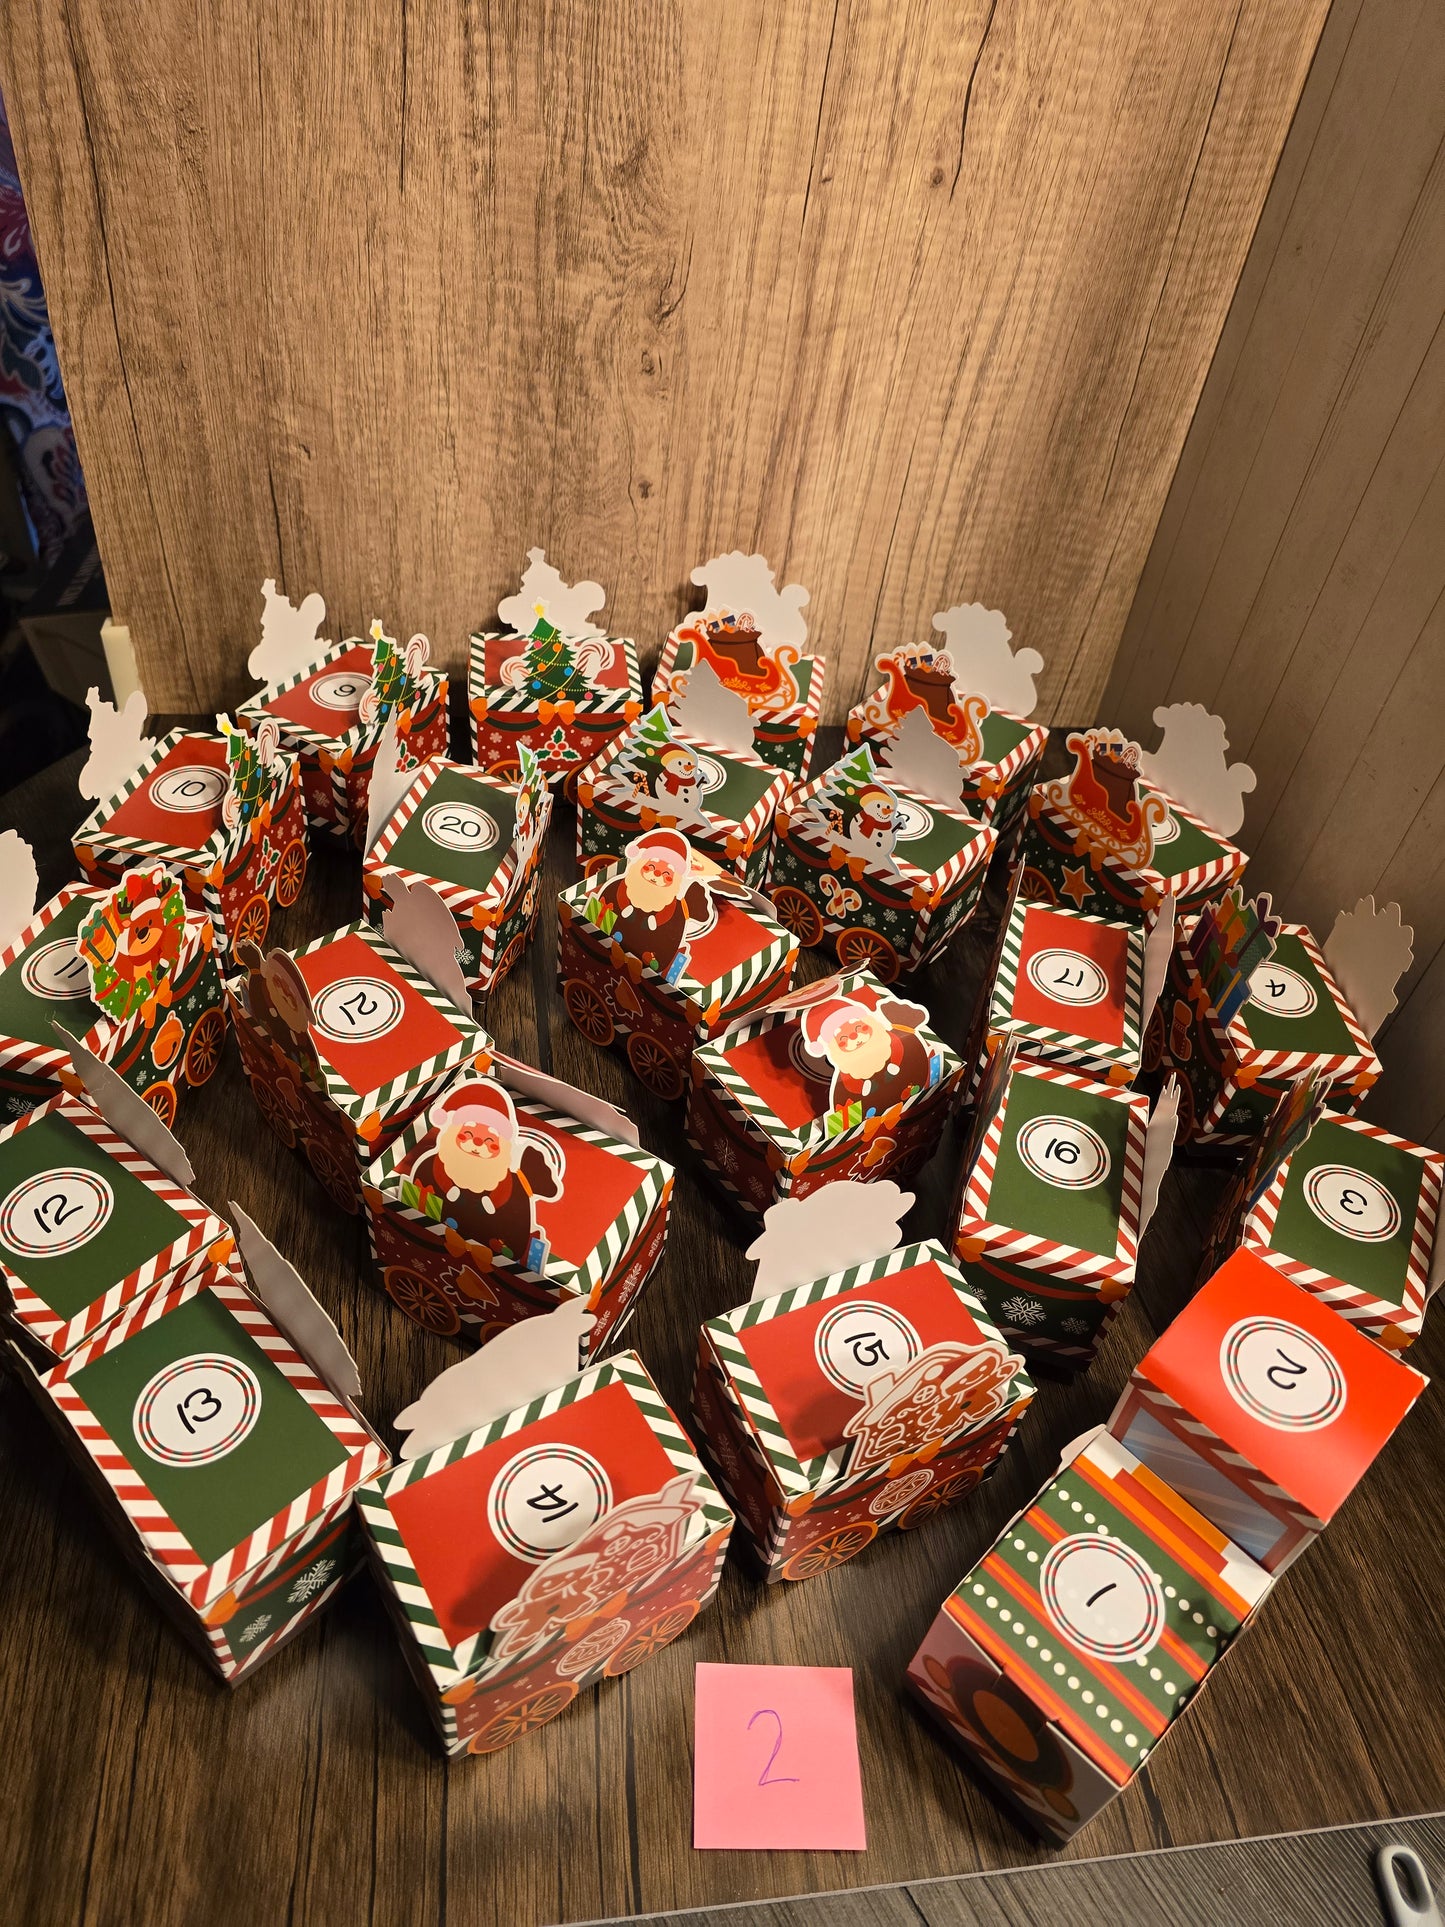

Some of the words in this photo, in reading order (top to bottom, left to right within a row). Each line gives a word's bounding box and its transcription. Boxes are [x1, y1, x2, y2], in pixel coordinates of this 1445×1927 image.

[171, 779, 207, 797] 10
[438, 815, 482, 838] 20
[53, 956, 88, 979] 11
[1052, 967, 1084, 988] 17
[1264, 978, 1286, 998] 4
[1044, 1137, 1081, 1165] 16
[33, 1193, 84, 1234] 12
[1339, 1189, 1368, 1216] 3
[843, 1331, 890, 1367] 15
[1266, 1348, 1308, 1391] 2
[176, 1387, 222, 1435] 13
[526, 1483, 580, 1524] 14
[1086, 1582, 1118, 1608] 1
[747, 1709, 801, 1787] 2
